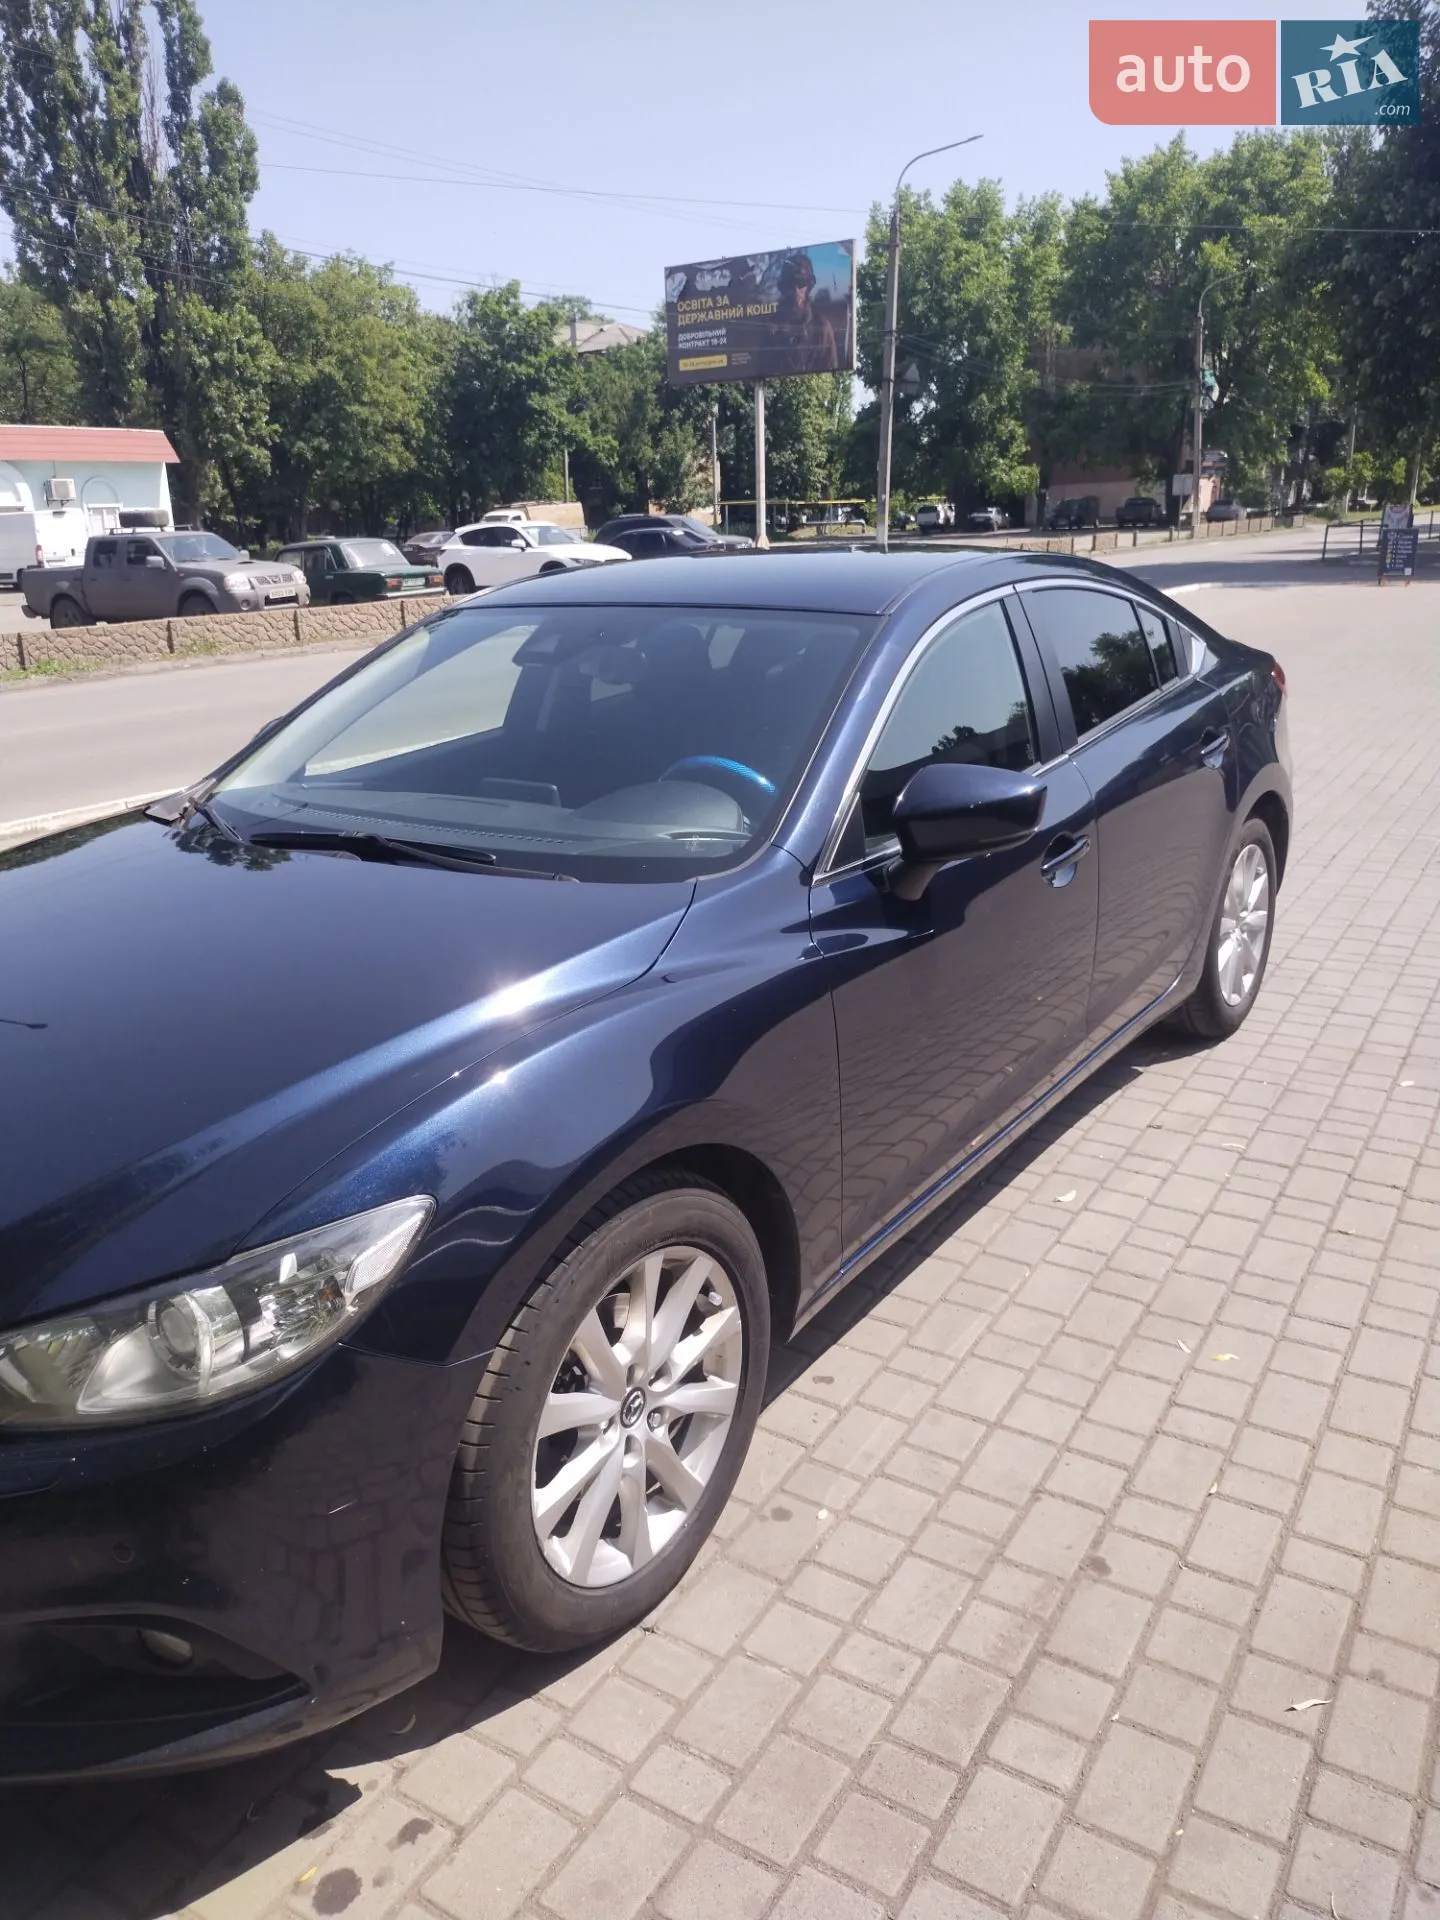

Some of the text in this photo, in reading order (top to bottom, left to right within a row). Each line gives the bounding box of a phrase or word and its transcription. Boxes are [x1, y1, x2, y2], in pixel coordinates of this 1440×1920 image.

[677, 294, 730, 312] ОСВІТА ЗА
[677, 302, 779, 327] ДЕРЖАВНИЙ КОШТ
[678, 327, 727, 342] ДОБРОВІЛЬНИЙ
[678, 339, 710, 349] КОНТРАКТ
